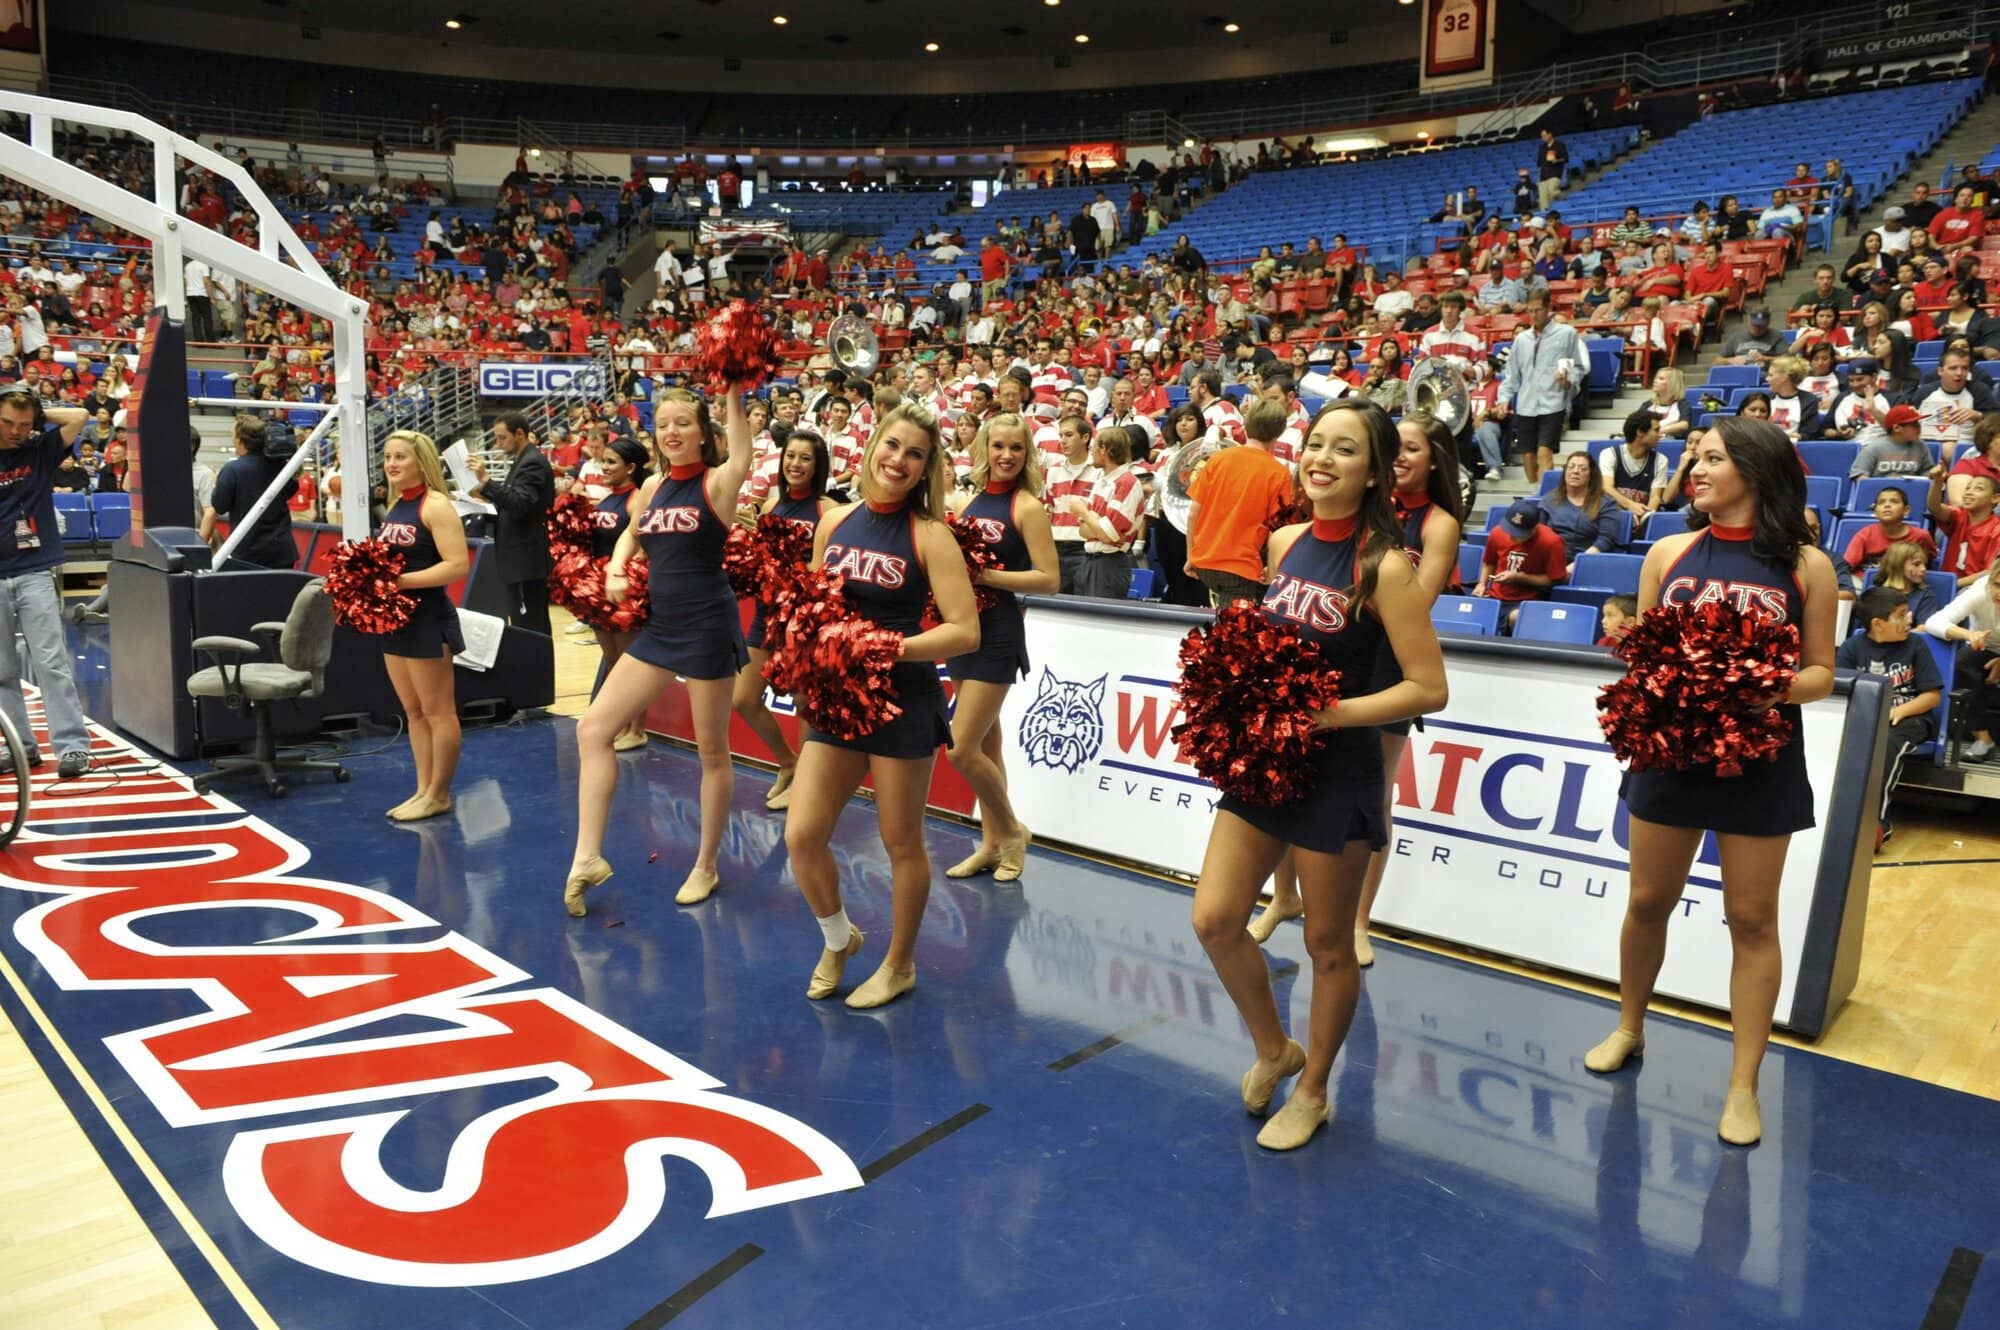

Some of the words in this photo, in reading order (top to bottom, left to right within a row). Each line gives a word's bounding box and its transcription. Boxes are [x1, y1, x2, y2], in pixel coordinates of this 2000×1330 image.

[1443, 12, 1470, 33] 32
[1886, 4, 1911, 19] 121
[1827, 45, 1859, 58] HALL
[1865, 42, 1883, 52] OF
[1887, 27, 1970, 49] CHAMPIONS
[483, 368, 600, 391] GEICO
[377, 522, 417, 546] ATS
[822, 544, 907, 589] CATS
[1662, 577, 1789, 625] CATS
[1098, 776, 1220, 814] EVERY
